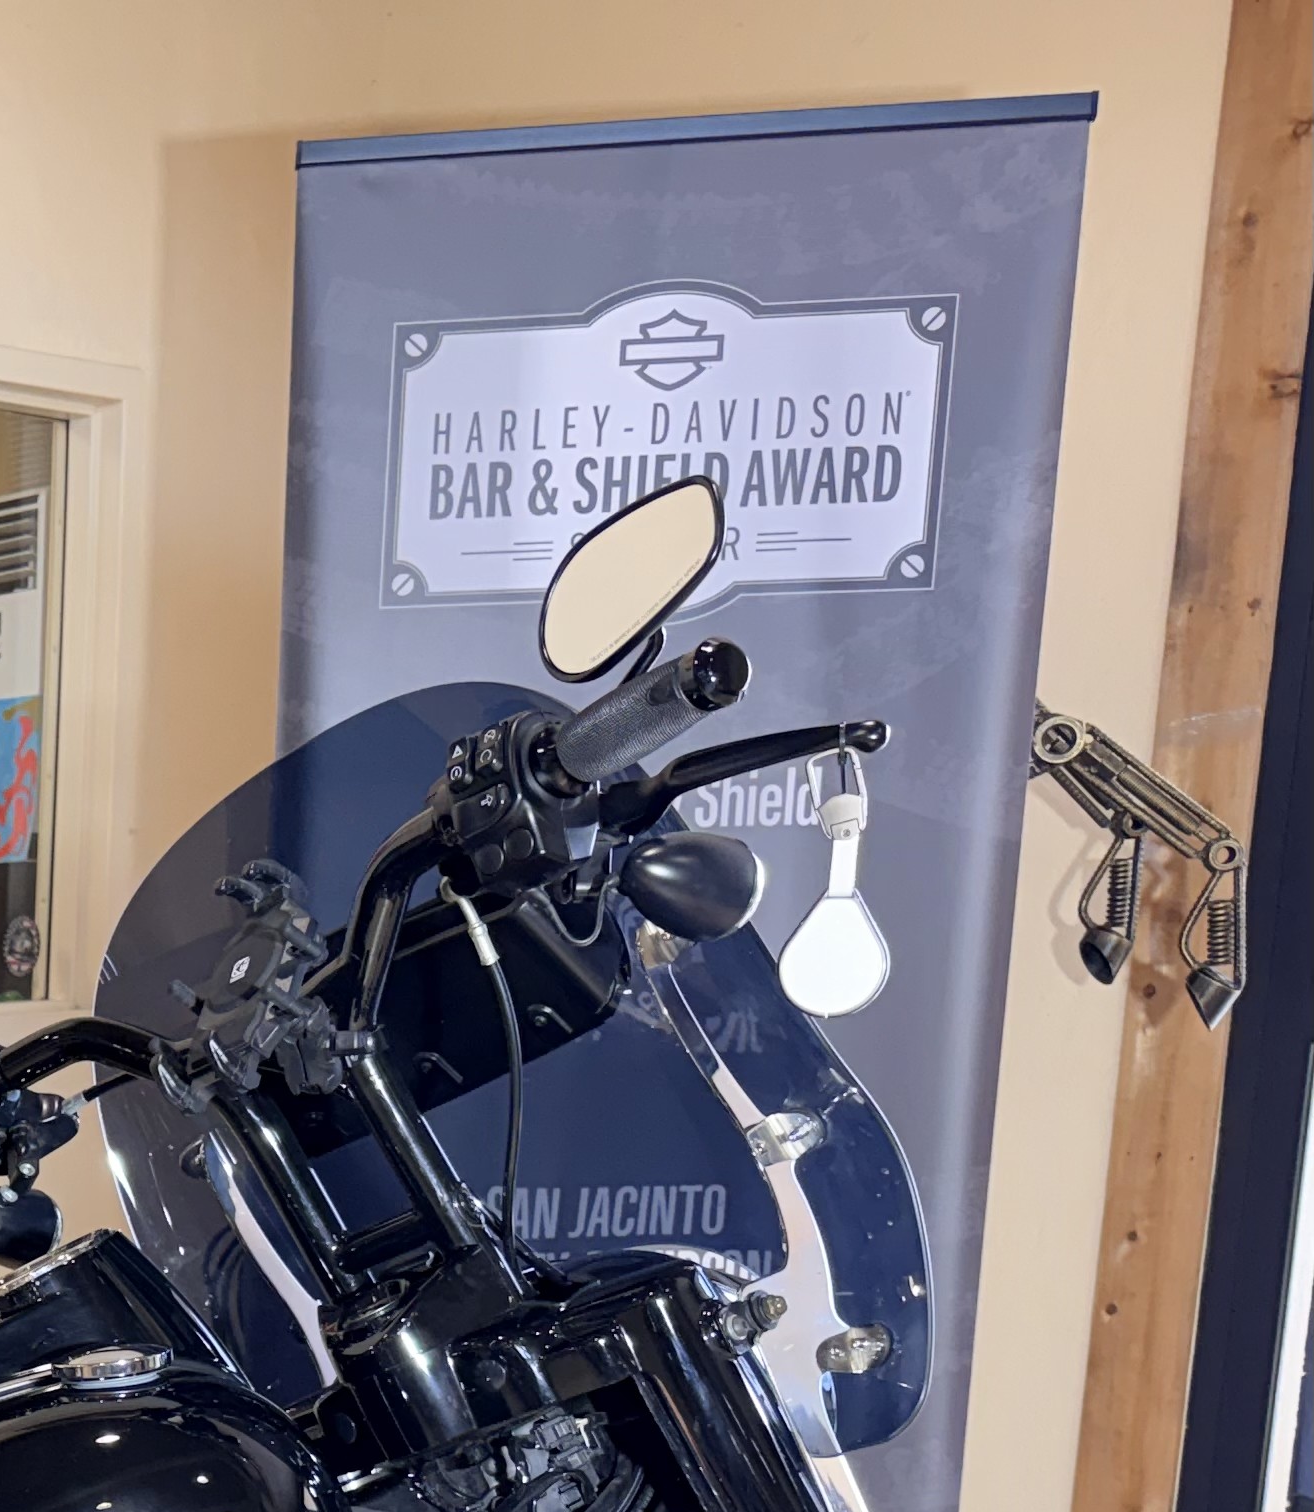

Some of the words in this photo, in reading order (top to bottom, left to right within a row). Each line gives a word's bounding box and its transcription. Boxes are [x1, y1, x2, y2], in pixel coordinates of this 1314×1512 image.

[429, 461, 512, 520] BAR
[528, 458, 559, 516] &
[740, 445, 903, 508] AWARD
[695, 767, 822, 828] Shield
[568, 1184, 726, 1238] JACINTO
